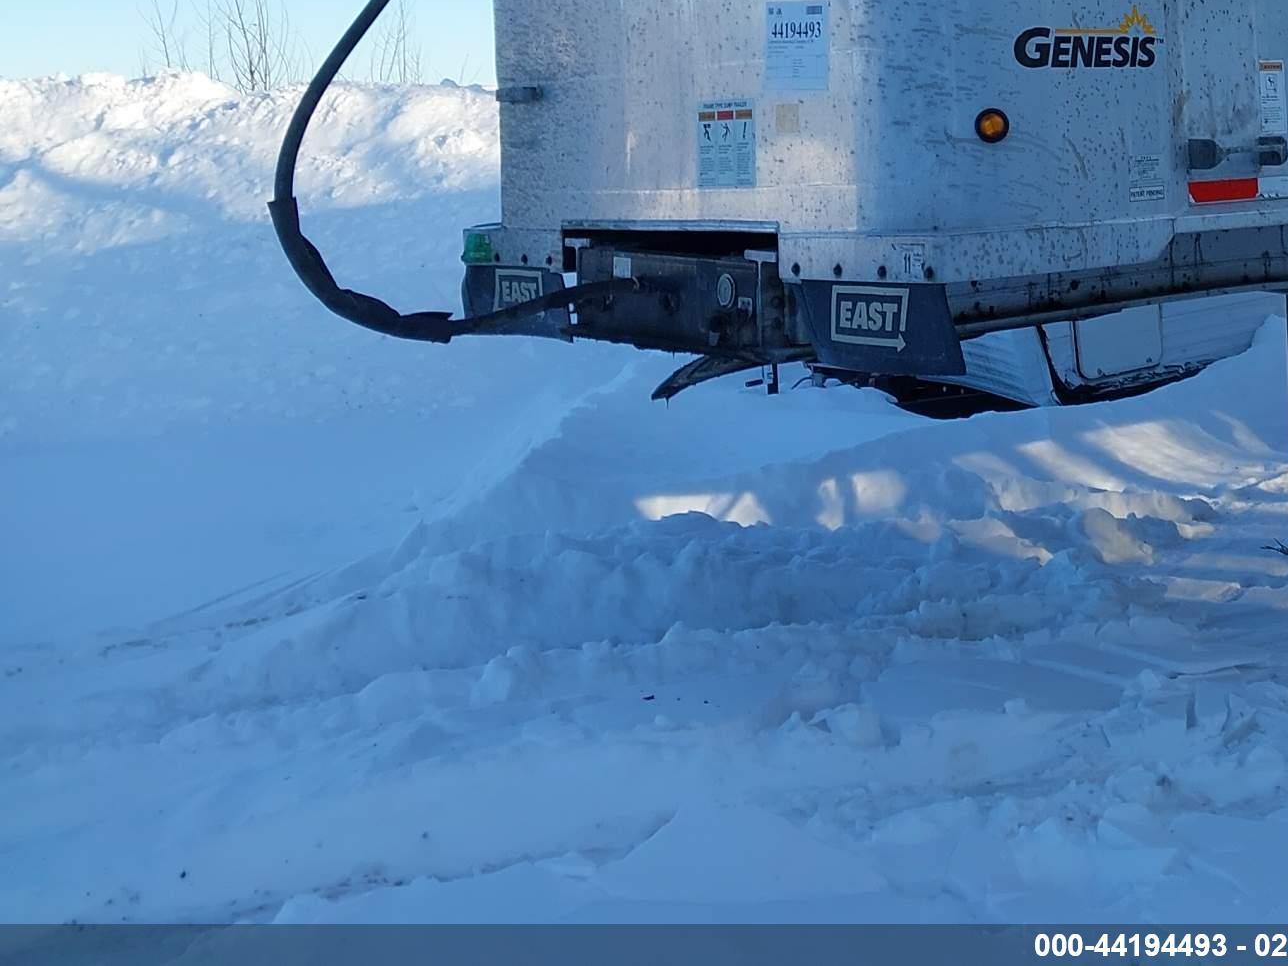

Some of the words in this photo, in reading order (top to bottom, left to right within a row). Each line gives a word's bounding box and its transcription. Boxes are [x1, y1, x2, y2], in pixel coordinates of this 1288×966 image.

[771, 21, 822, 39] 44194493
[1014, 27, 1156, 68] GENESIS
[501, 281, 537, 303] EAST
[839, 301, 898, 332] EAST
